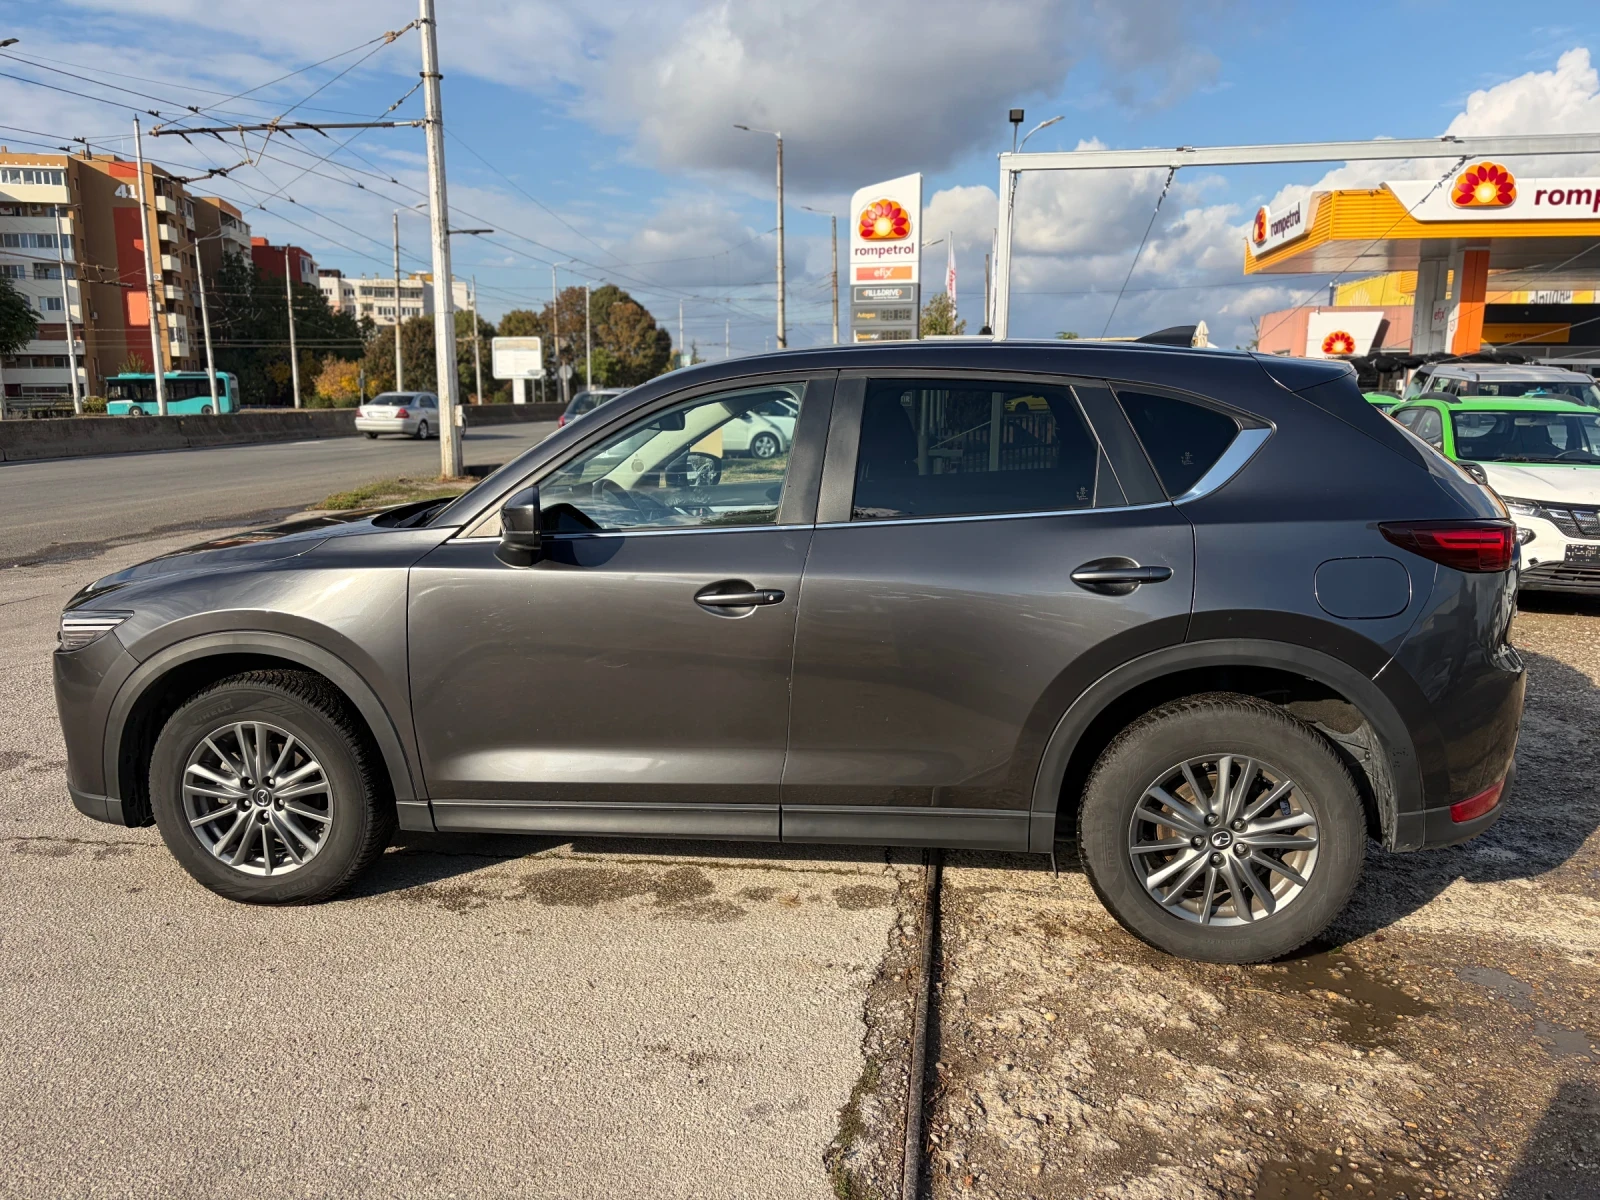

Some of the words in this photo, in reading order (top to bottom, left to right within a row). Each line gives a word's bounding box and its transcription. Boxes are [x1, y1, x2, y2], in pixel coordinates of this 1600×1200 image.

[114, 184, 138, 198] 41
[1271, 202, 1300, 238] rompetrol
[854, 243, 914, 258] rompetrol
[874, 267, 894, 279] efix
